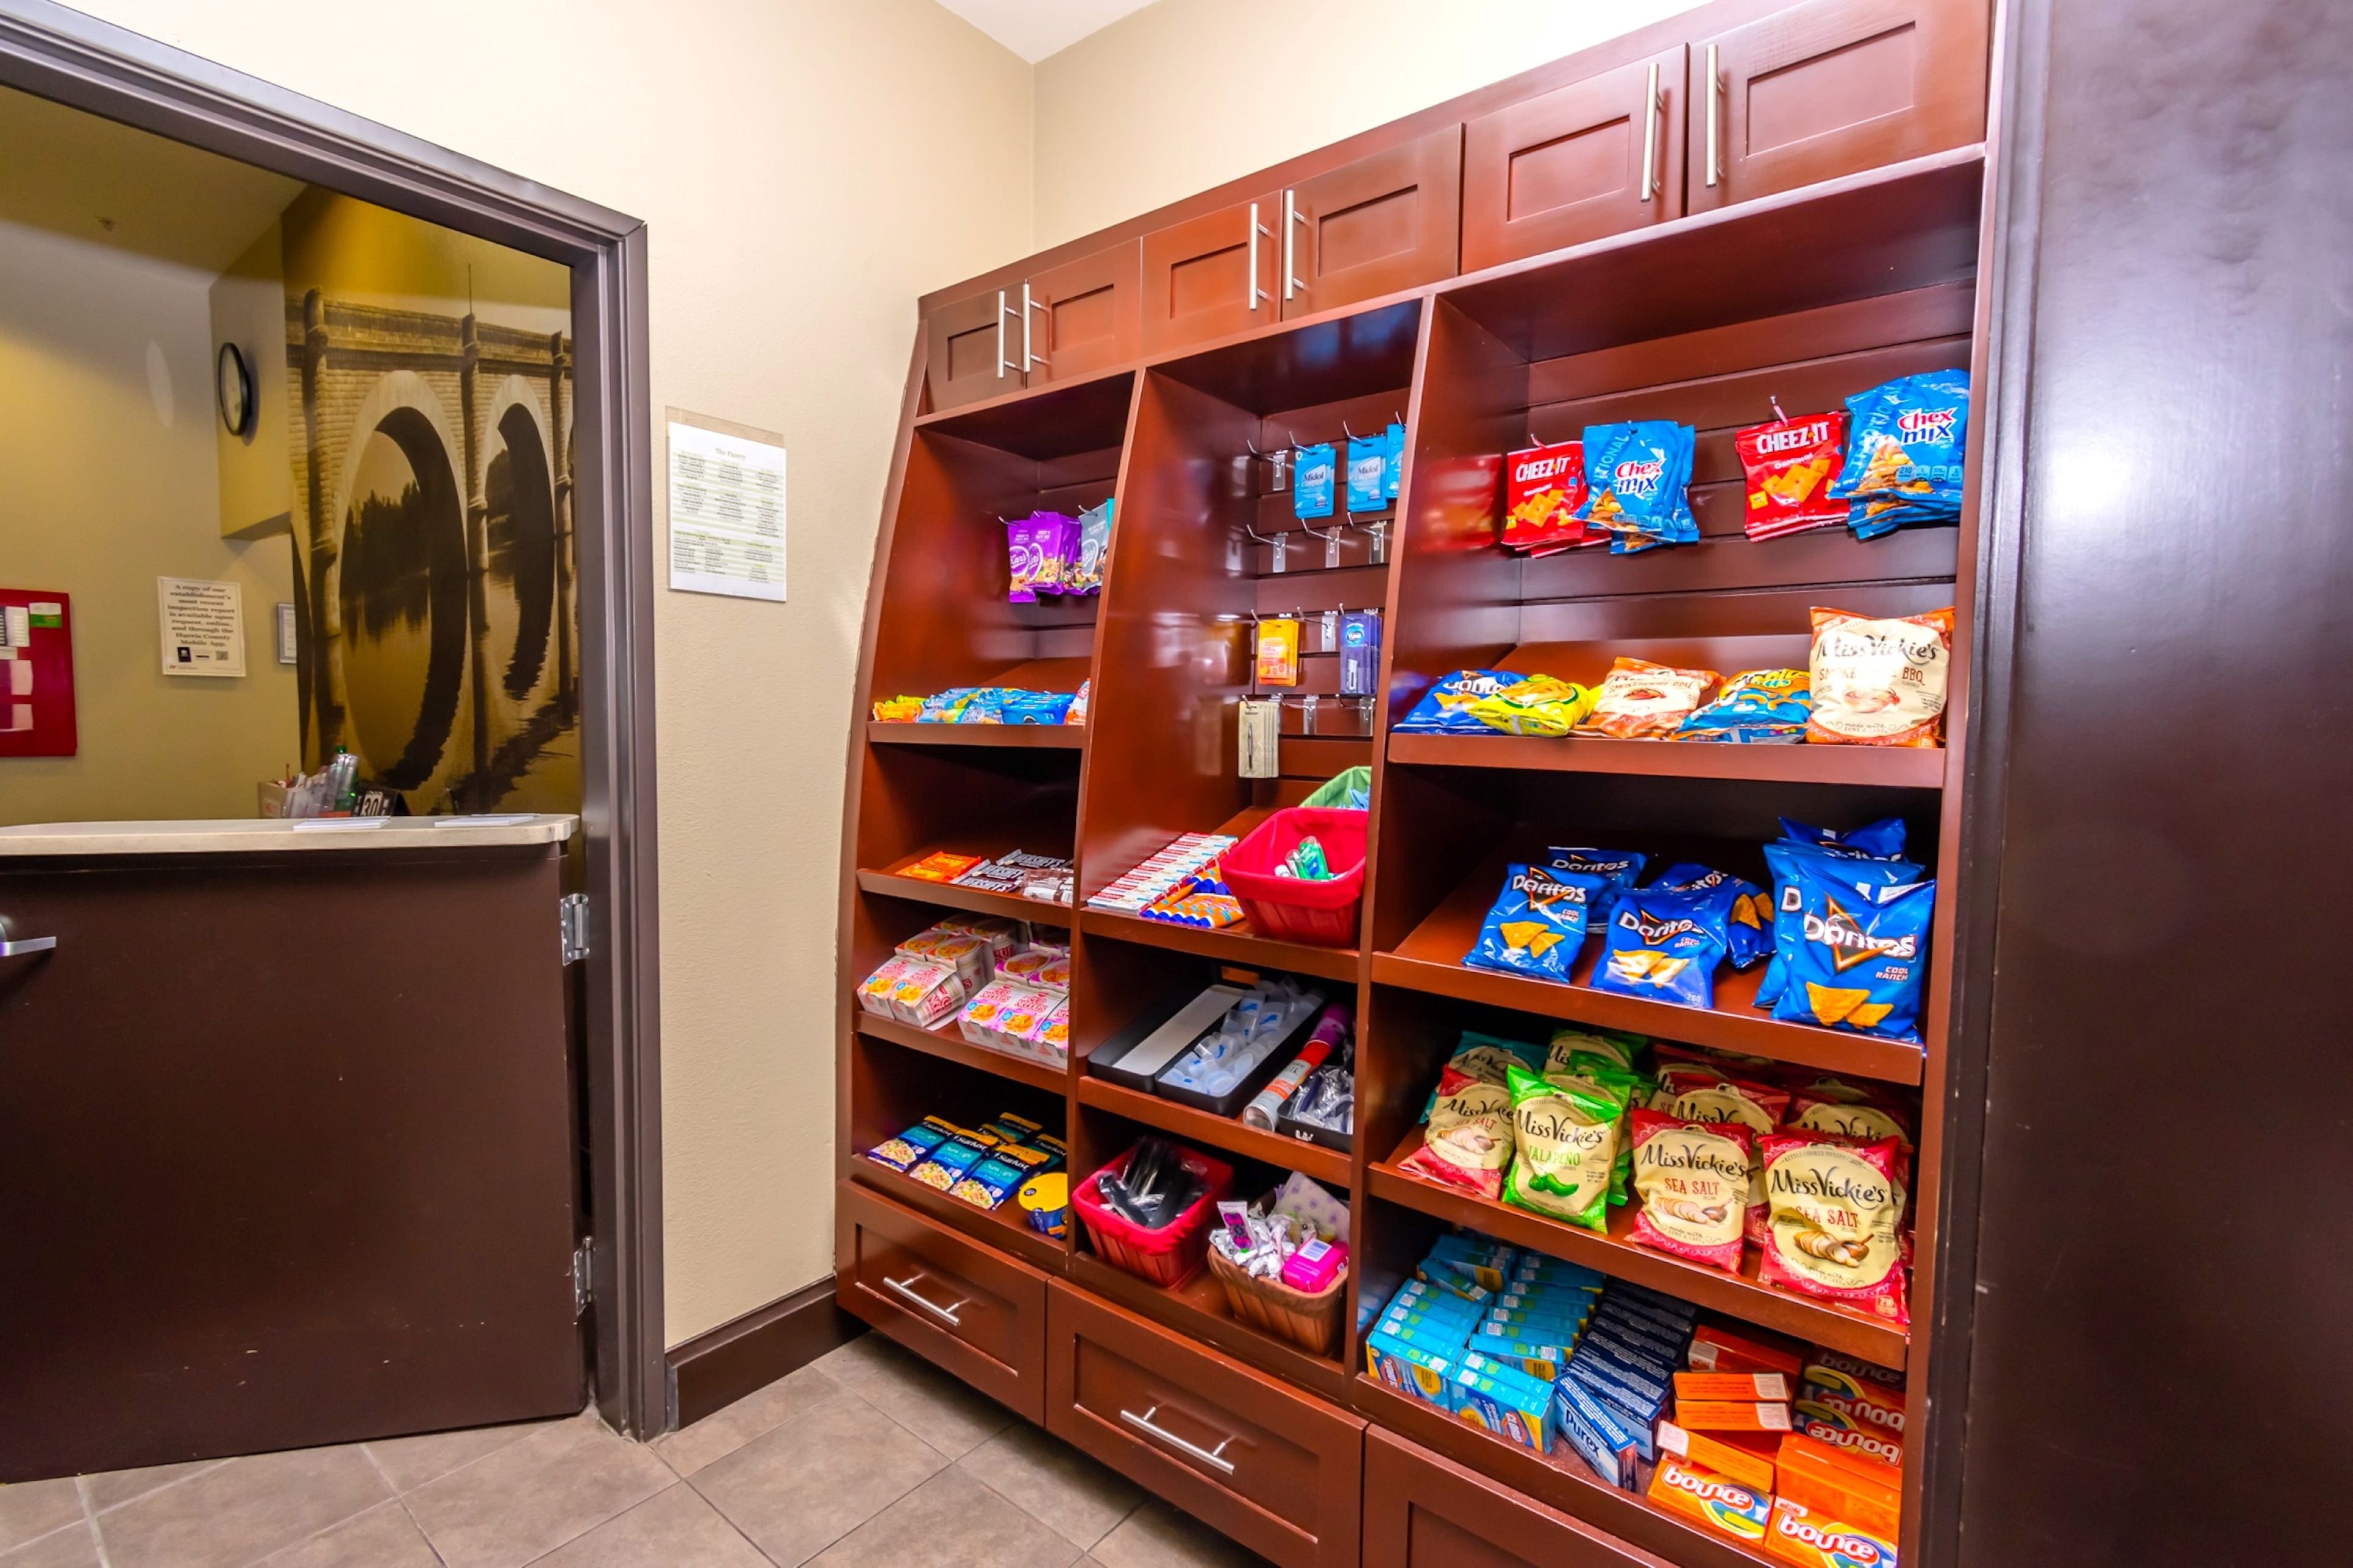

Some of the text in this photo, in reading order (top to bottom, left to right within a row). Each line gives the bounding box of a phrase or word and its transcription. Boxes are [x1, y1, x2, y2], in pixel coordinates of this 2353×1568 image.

[1897, 409, 1955, 430] Chex
[1903, 425, 1953, 444] mix
[727, 451, 746, 460] Pantry
[1303, 471, 1324, 481] Midol
[1356, 464, 1379, 475] Midol
[1616, 461, 1661, 478] Chex
[1618, 475, 1658, 494] mix
[1902, 667, 1925, 686] BBQ
[1552, 859, 1629, 871] Doritos
[1513, 874, 1586, 903] Doritos
[1618, 912, 1704, 938] Doritos
[1804, 915, 1917, 957] Doritos
[1876, 972, 1908, 981] RANCH
[1442, 1099, 1481, 1116] Miss
[1473, 1117, 1497, 1130] SALT
[1517, 1109, 1604, 1150] Miss Vickie's
[1528, 1146, 1580, 1166] JALAPEÑO
[1640, 1143, 1748, 1183] Miss Vickie's
[1665, 1177, 1720, 1196] SEA SALT
[1770, 1166, 1887, 1210] Miss Vickie's
[1795, 1206, 1858, 1228] SEA SALT
[1820, 1353, 1901, 1383] bounce
[1566, 1409, 1600, 1458] Purex
[1809, 1425, 1901, 1463] bounce
[1663, 1464, 1752, 1507] bounce
[1779, 1514, 1875, 1559] bounce
